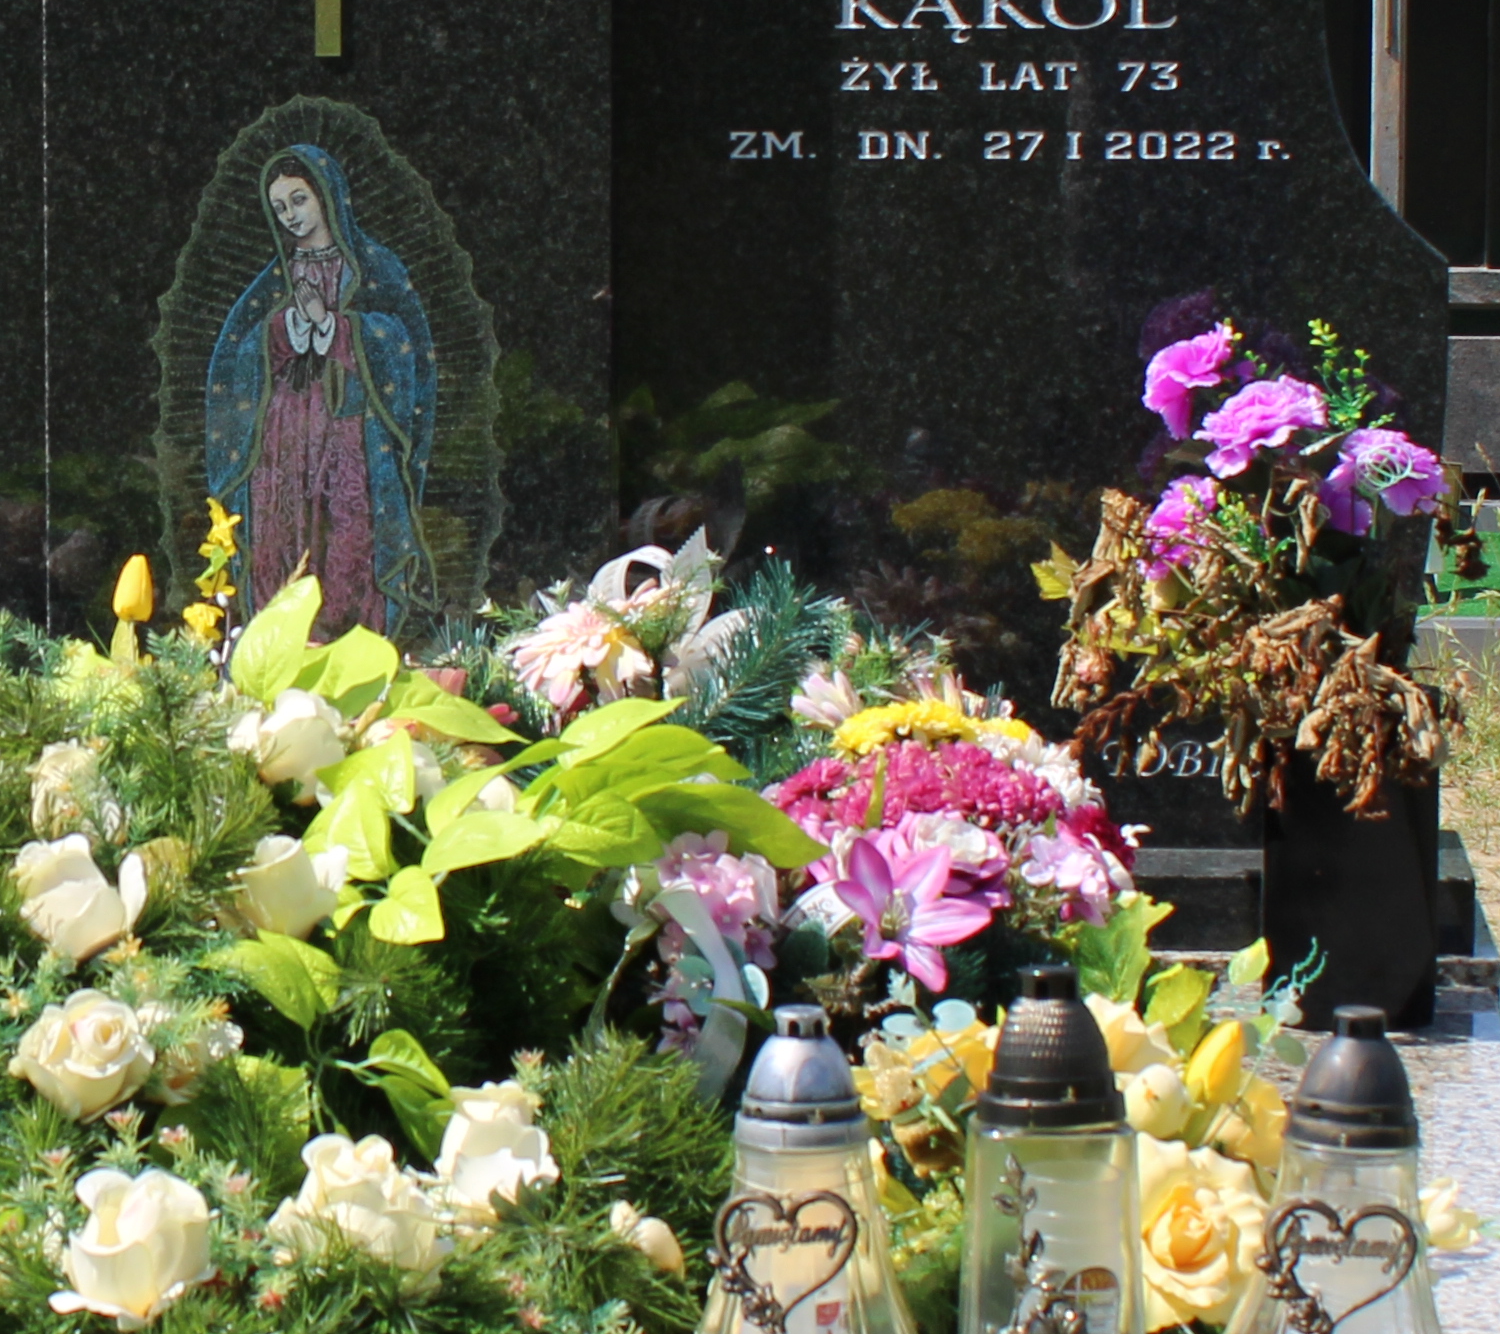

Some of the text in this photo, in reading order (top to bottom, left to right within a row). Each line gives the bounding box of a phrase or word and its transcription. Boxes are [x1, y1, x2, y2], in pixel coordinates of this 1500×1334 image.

[840, 56, 1179, 92] ŻYŁ LAT 73
[729, 131, 1291, 160] ZM. DN. 27 I 2022 r.
